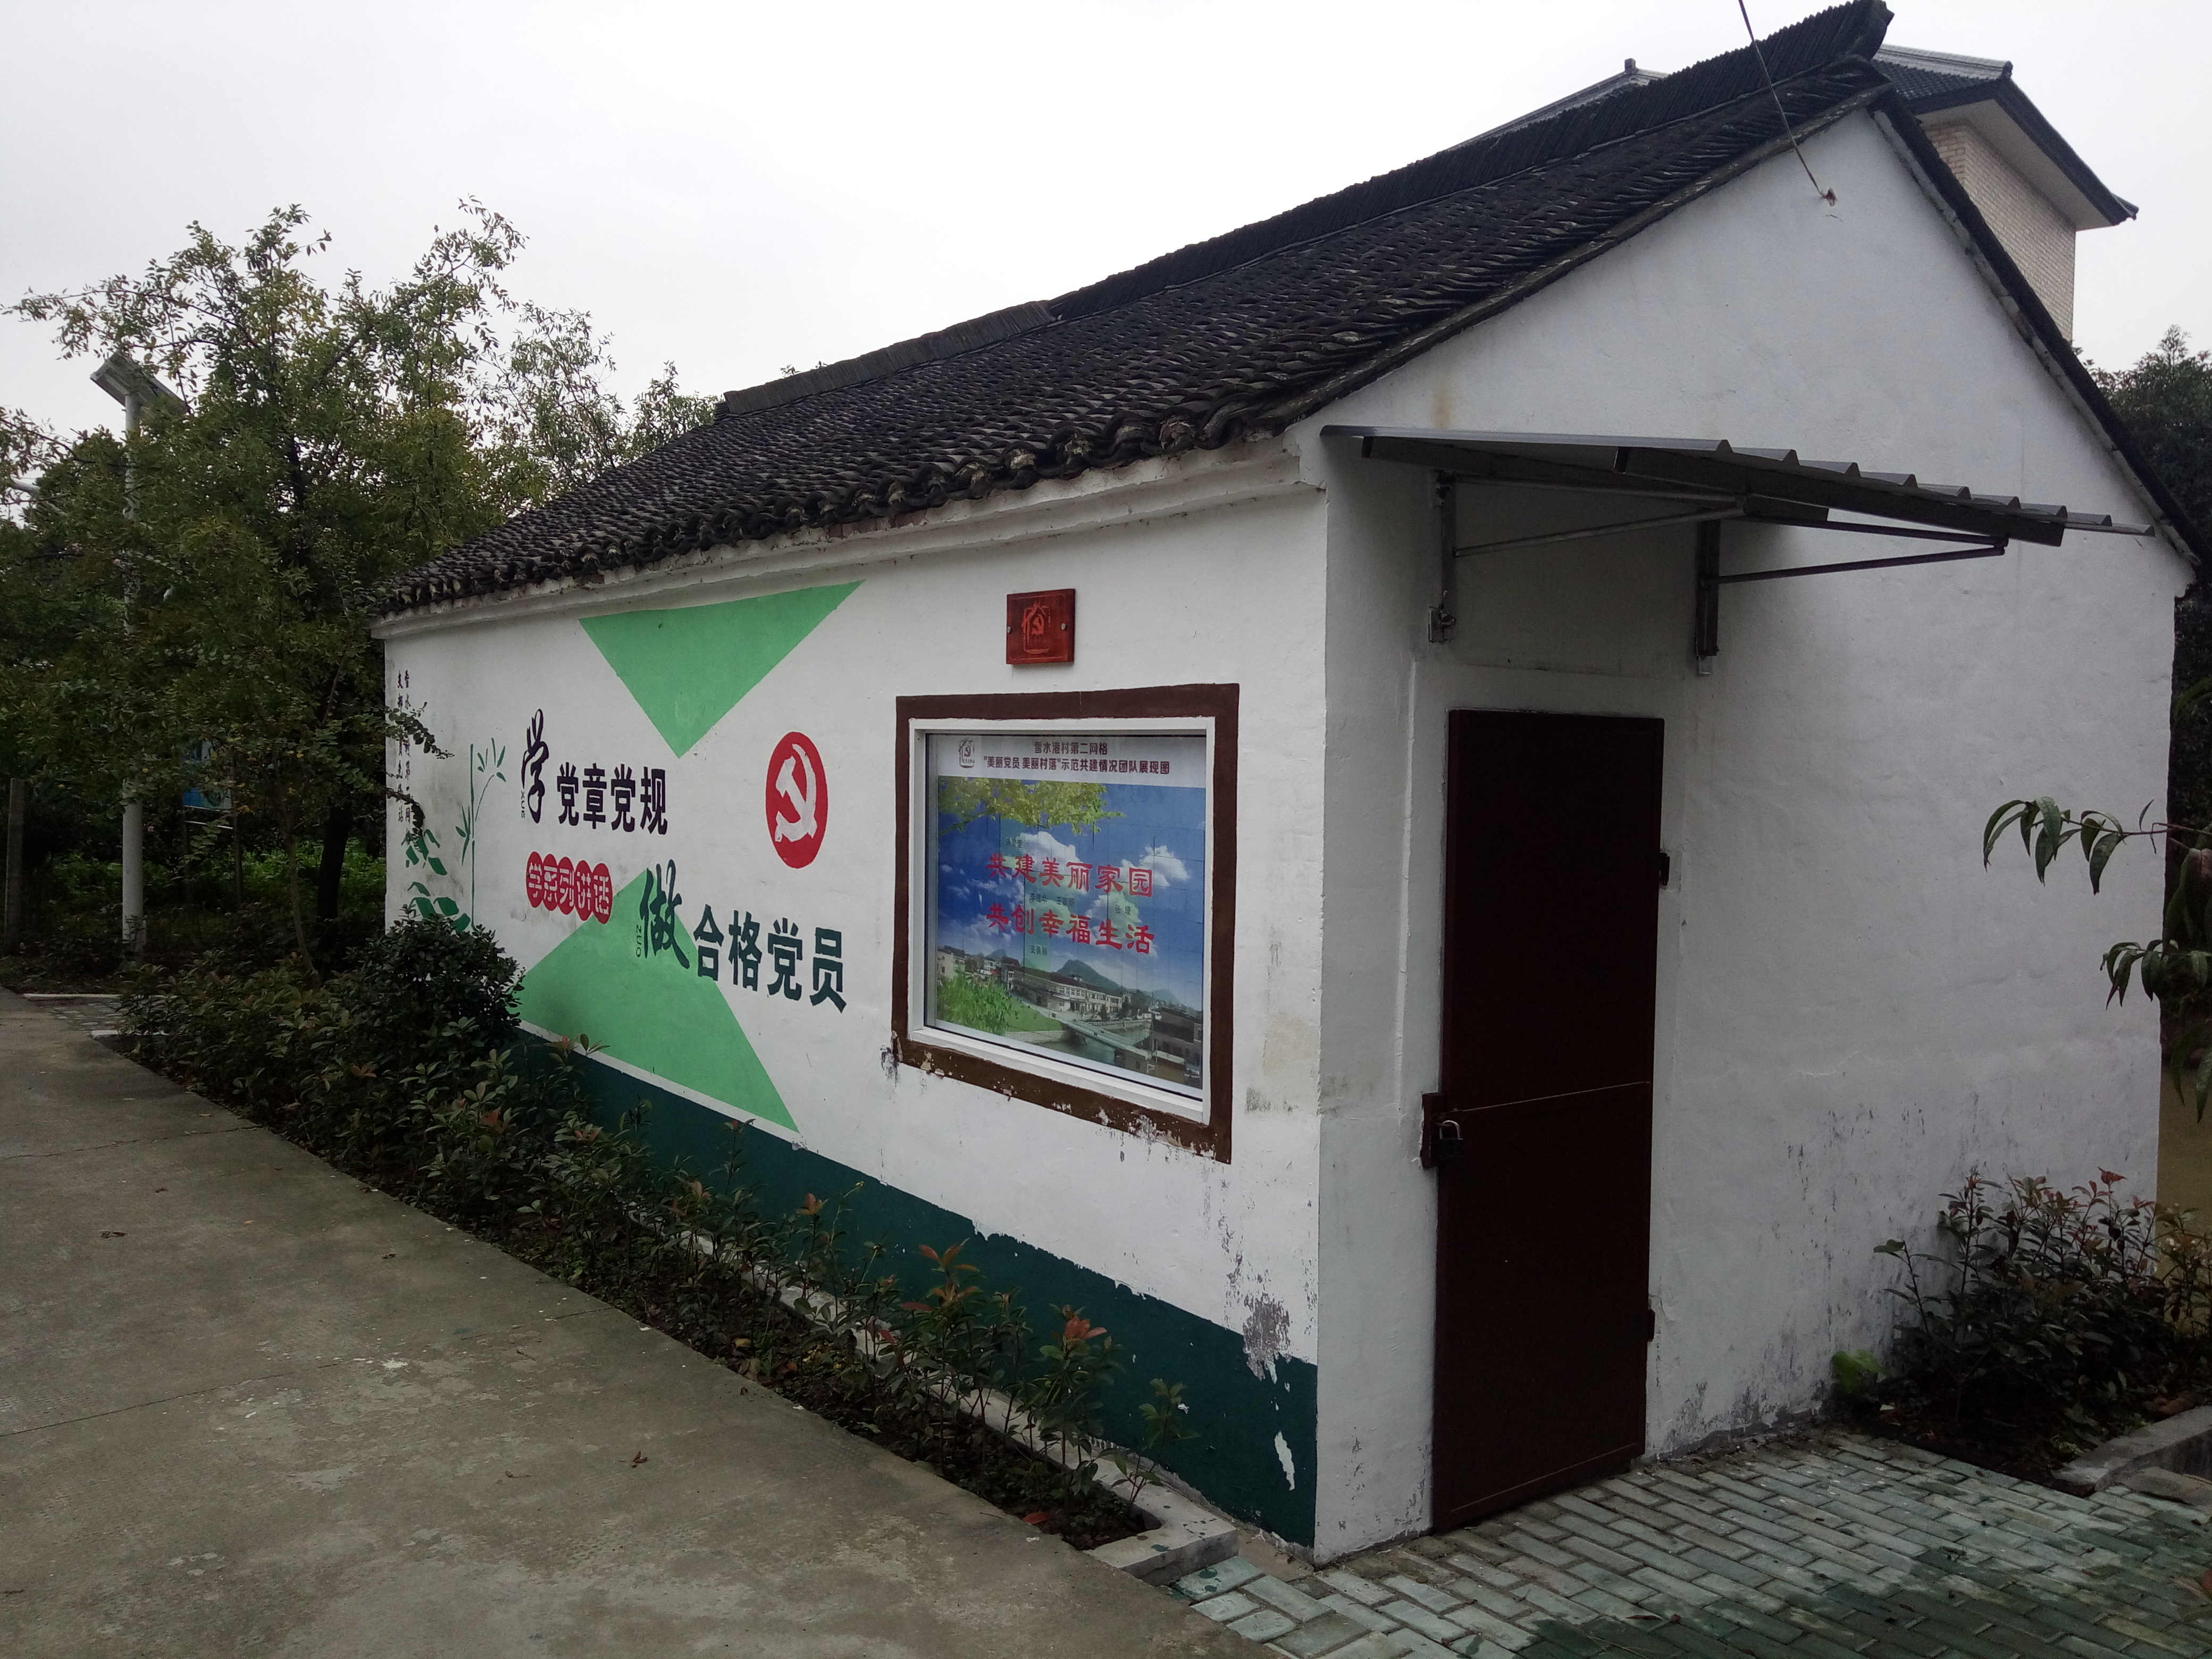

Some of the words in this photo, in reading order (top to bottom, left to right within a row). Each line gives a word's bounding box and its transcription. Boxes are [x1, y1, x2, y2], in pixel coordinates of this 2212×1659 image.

[521, 709, 549, 824] 学
[557, 762, 667, 835] 党章党规
[527, 861, 610, 916] 学系列讲话
[987, 852, 1153, 898] 共建美丽家园
[640, 859, 690, 969] 做
[693, 904, 847, 1013] 合格党员
[986, 902, 1155, 954] 共创幸福生活
